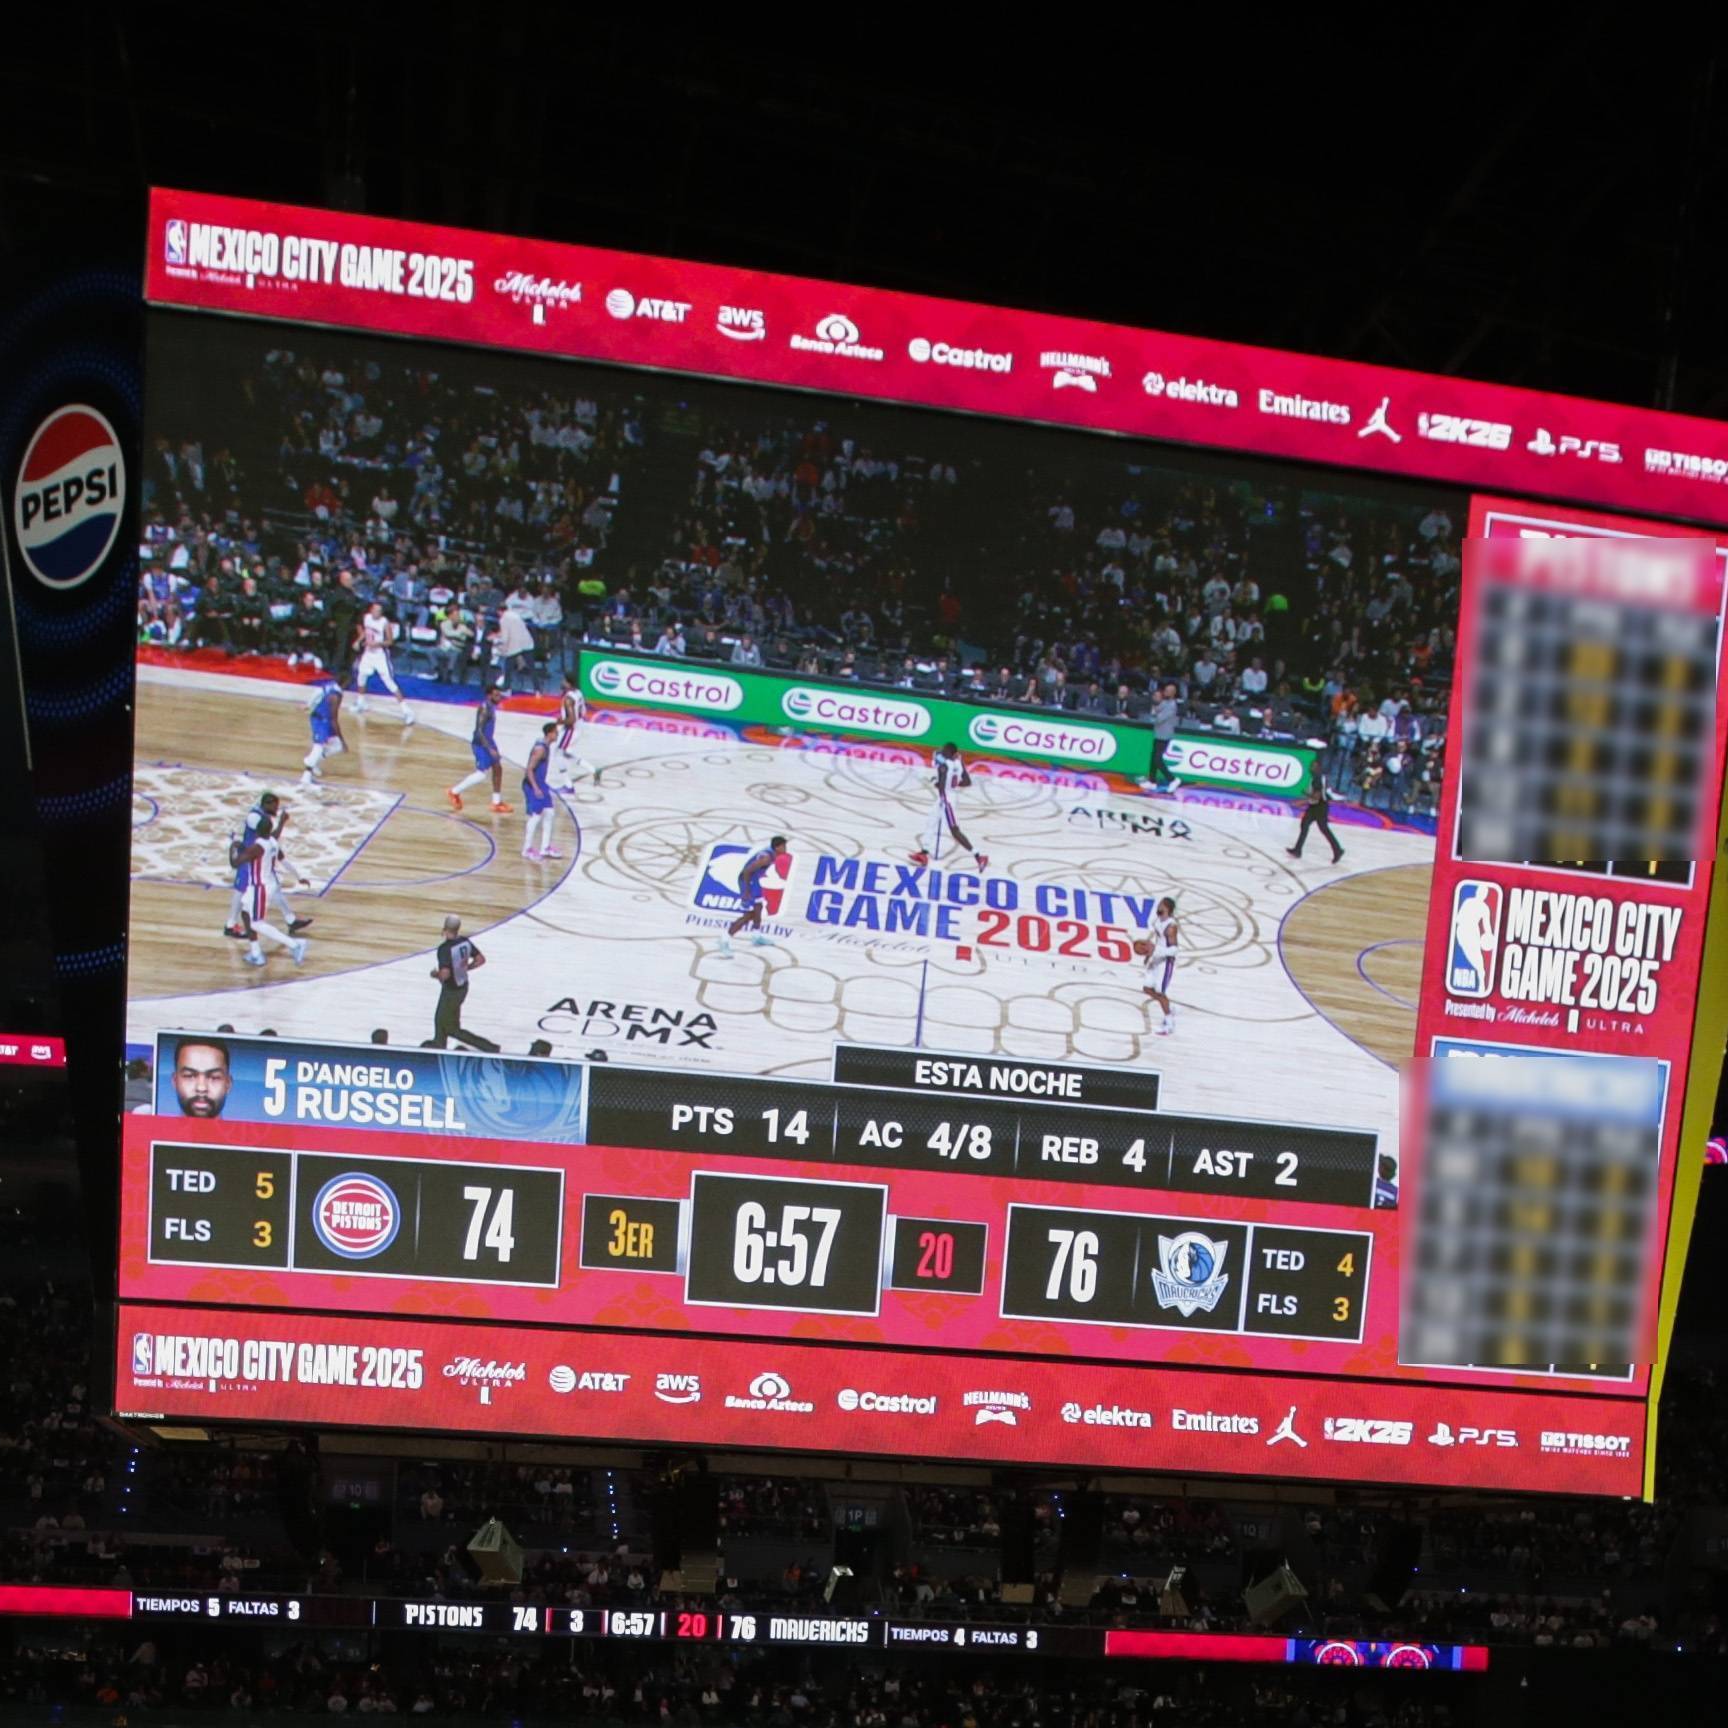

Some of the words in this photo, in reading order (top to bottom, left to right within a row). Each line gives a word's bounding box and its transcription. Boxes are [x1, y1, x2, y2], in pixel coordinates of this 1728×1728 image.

[189, 222, 279, 276] MEXICO
[281, 236, 338, 284] CITY
[340, 244, 404, 294] GAME
[407, 253, 475, 303] 2025
[494, 271, 582, 301] Michelob
[636, 298, 692, 323] AT&T
[718, 306, 764, 329] aws
[932, 342, 1013, 373] Castrol
[1166, 377, 1238, 407] elektra
[1258, 389, 1351, 425] Emirates
[1427, 414, 1513, 451] 2K26
[1559, 435, 1622, 463] PS5
[22, 463, 118, 530] PEPSI
[626, 672, 730, 705] Castrol
[816, 698, 920, 730] Castrol
[1003, 724, 1106, 755] Castrol
[1189, 750, 1291, 782] Castrol
[1071, 806, 1192, 834] ARENA
[812, 855, 1018, 912] MEXICO
[1035, 884, 1156, 929] CITY
[773, 925, 793, 939] by
[805, 888, 964, 941] GAME
[976, 910, 1133, 963] 2025
[1506, 888, 1613, 953] MEXICO
[1615, 901, 1682, 961] CITY
[1452, 968, 1476, 988] NBA
[1500, 944, 1580, 1006] GAME
[1580, 953, 1659, 1014] 2025
[547, 997, 718, 1031] ARENA
[1498, 1005, 1559, 1027] Michelob
[1586, 1018, 1644, 1034] ULTRA
[537, 1015, 715, 1049] CDMX
[262, 1058, 286, 1116] 5
[296, 1061, 413, 1091] D'ANGELO
[914, 1060, 983, 1089] ESTA
[989, 1067, 1083, 1098] NOCHE
[296, 1088, 466, 1130] RUSSELL
[671, 1104, 733, 1135] PTS
[761, 1108, 810, 1144] 14
[859, 1120, 903, 1148] AC
[926, 1122, 992, 1160] 4/8
[1041, 1134, 1098, 1165] REB
[1122, 1139, 1147, 1172] 4
[1192, 1150, 1253, 1178] AST
[1274, 1152, 1298, 1186] 2
[166, 1169, 216, 1192] TED
[255, 1172, 274, 1199] 5
[331, 1200, 382, 1217] DETROIT
[463, 1185, 515, 1263] 74
[165, 1218, 211, 1241] FLS
[253, 1220, 272, 1248] 3
[608, 1209, 654, 1258] 3ER
[733, 1201, 841, 1287] 6:57
[916, 1231, 954, 1280] 20
[1045, 1228, 1099, 1303] 76
[1262, 1248, 1304, 1272] TED
[1337, 1253, 1355, 1277] 4
[1257, 1293, 1298, 1316] FLS
[1333, 1296, 1350, 1322] 3
[154, 1335, 239, 1379] MEXICO
[243, 1340, 295, 1383] CITY
[297, 1343, 359, 1386] GAME
[361, 1347, 423, 1389] 2025
[443, 1356, 526, 1381] Michelob
[578, 1372, 630, 1392] AT&T
[656, 1374, 700, 1392] aws
[860, 1391, 937, 1414] Castrol
[1083, 1405, 1152, 1428] elektra
[1172, 1409, 1259, 1435] Emirates
[1334, 1419, 1413, 1446] 2K26
[1459, 1427, 1518, 1447] PS5
[1568, 1433, 1630, 1451] TISSOT
[136, 1597, 200, 1614] TIEMPOS
[208, 1598, 220, 1618] 5
[228, 1601, 278, 1616] FALTAS
[288, 1601, 300, 1620] 3
[405, 1604, 483, 1628] PISTONS
[512, 1607, 537, 1632] 74
[570, 1610, 584, 1633] 3
[611, 1611, 654, 1636] 6:57
[677, 1613, 706, 1637] 20
[730, 1615, 756, 1640] 76
[770, 1618, 868, 1643] MAVERICKS
[891, 1627, 949, 1643] TIEMPOS
[954, 1628, 965, 1646] 4
[972, 1630, 1017, 1645] FALTAS
[1026, 1630, 1038, 1649] 3
